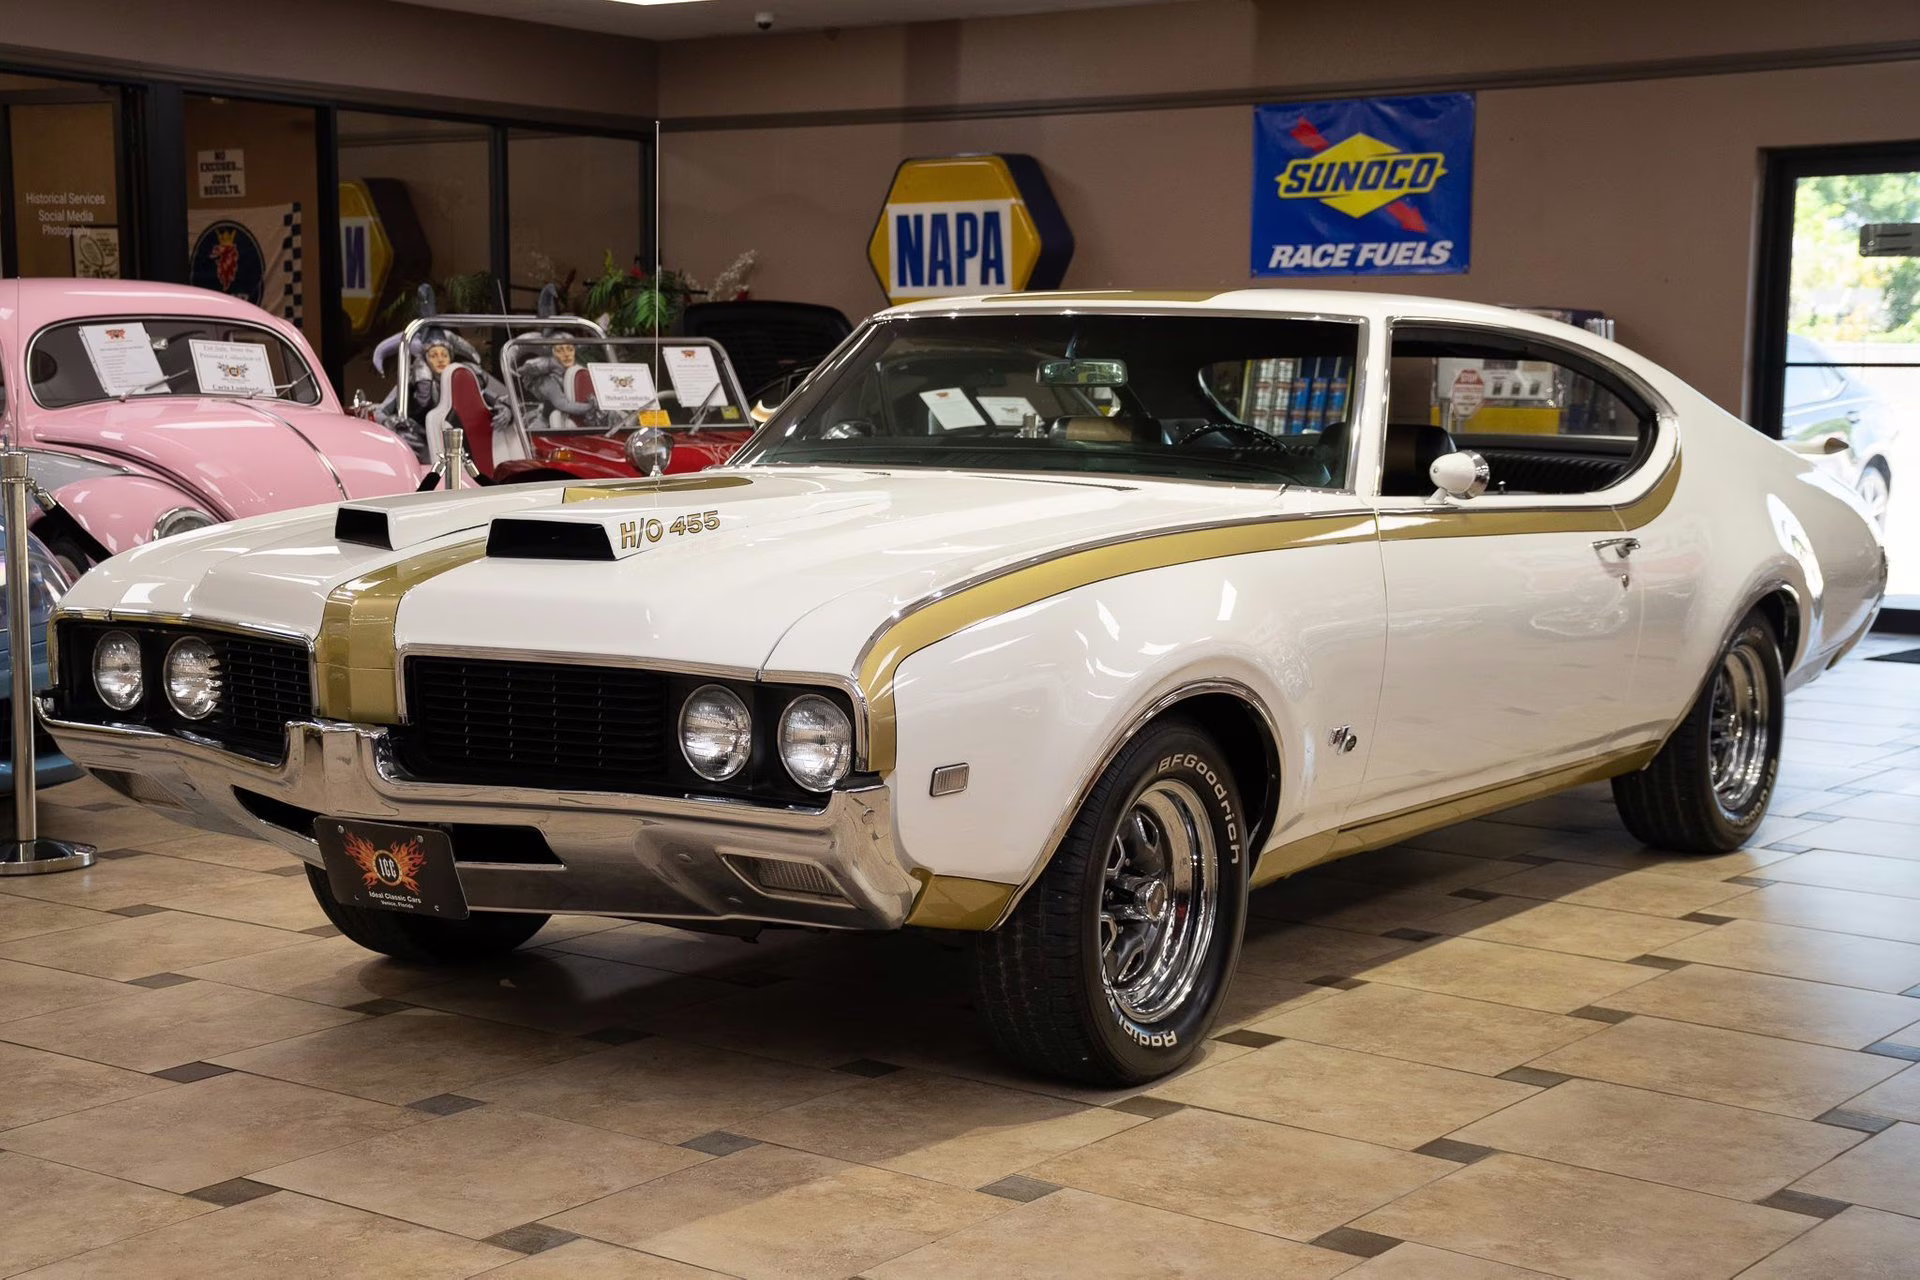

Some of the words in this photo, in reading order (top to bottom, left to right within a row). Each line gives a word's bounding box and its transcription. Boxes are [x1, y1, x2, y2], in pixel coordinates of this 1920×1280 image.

[214, 151, 226, 160] NO
[211, 174, 232, 184] JUST
[1283, 158, 1439, 194] SUNOCO
[26, 192, 67, 204] Historical
[69, 192, 106, 204] Services
[38, 209, 65, 221] Social
[66, 209, 94, 222] Media
[42, 224, 90, 238] Photography
[896, 210, 1005, 288] NAPA
[1268, 243, 1355, 268] RACE
[1355, 240, 1453, 267] FUELS
[620, 517, 664, 549] H/O
[669, 510, 721, 536] 455
[1157, 753, 1240, 864] BFGoodrich
[378, 857, 397, 878] ICC
[368, 890, 385, 899] Ideal
[385, 893, 407, 902] Classic
[407, 895, 422, 904] Cars
[1118, 1014, 1178, 1048] Radial
